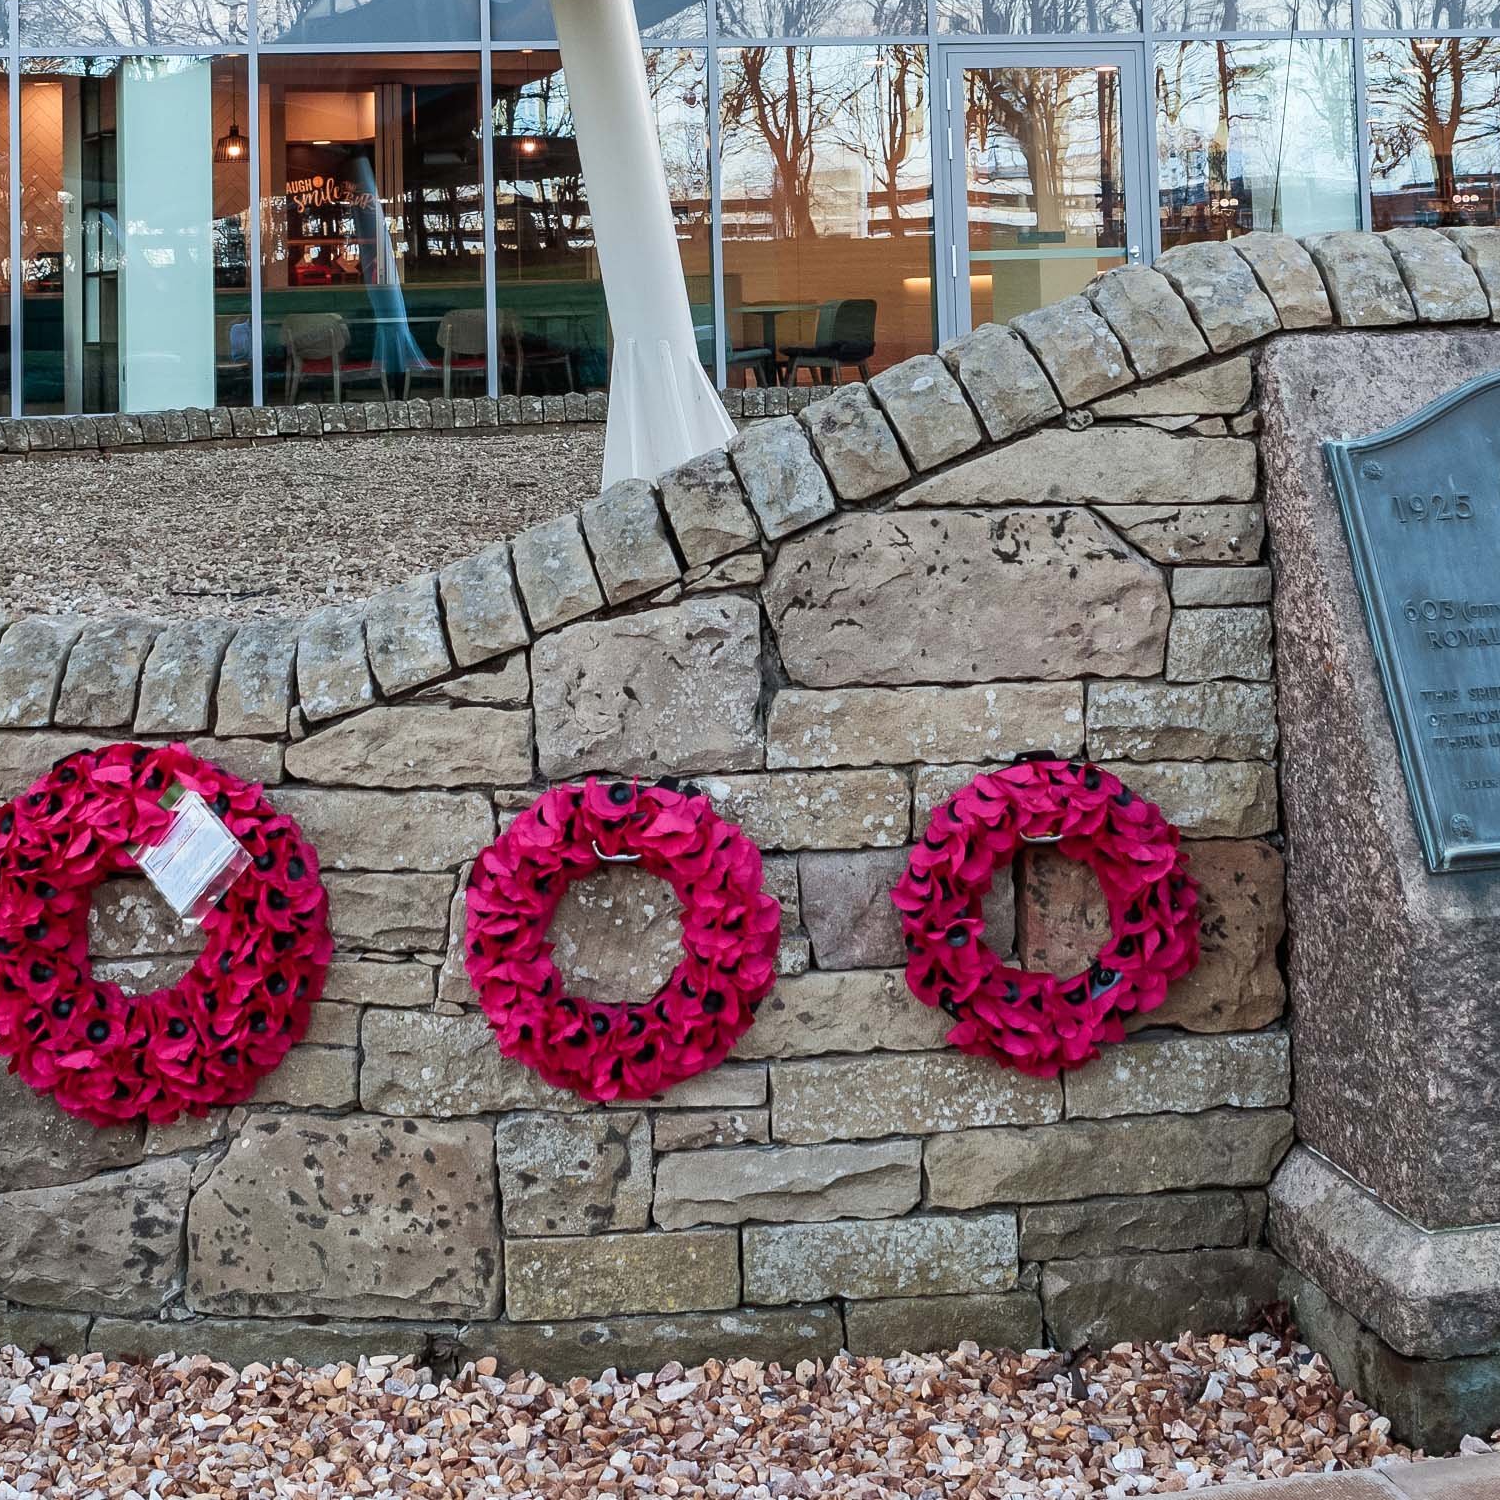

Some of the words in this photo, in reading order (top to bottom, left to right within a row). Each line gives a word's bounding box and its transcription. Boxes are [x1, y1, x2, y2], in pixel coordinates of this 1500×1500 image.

[293, 177, 341, 213] smile
[1391, 492, 1475, 524] 1925
[1403, 598, 1458, 623] 603
[1419, 688, 1461, 703] THIS
[1427, 713, 1448, 728] OF
[1430, 735, 1485, 750] THEIR
